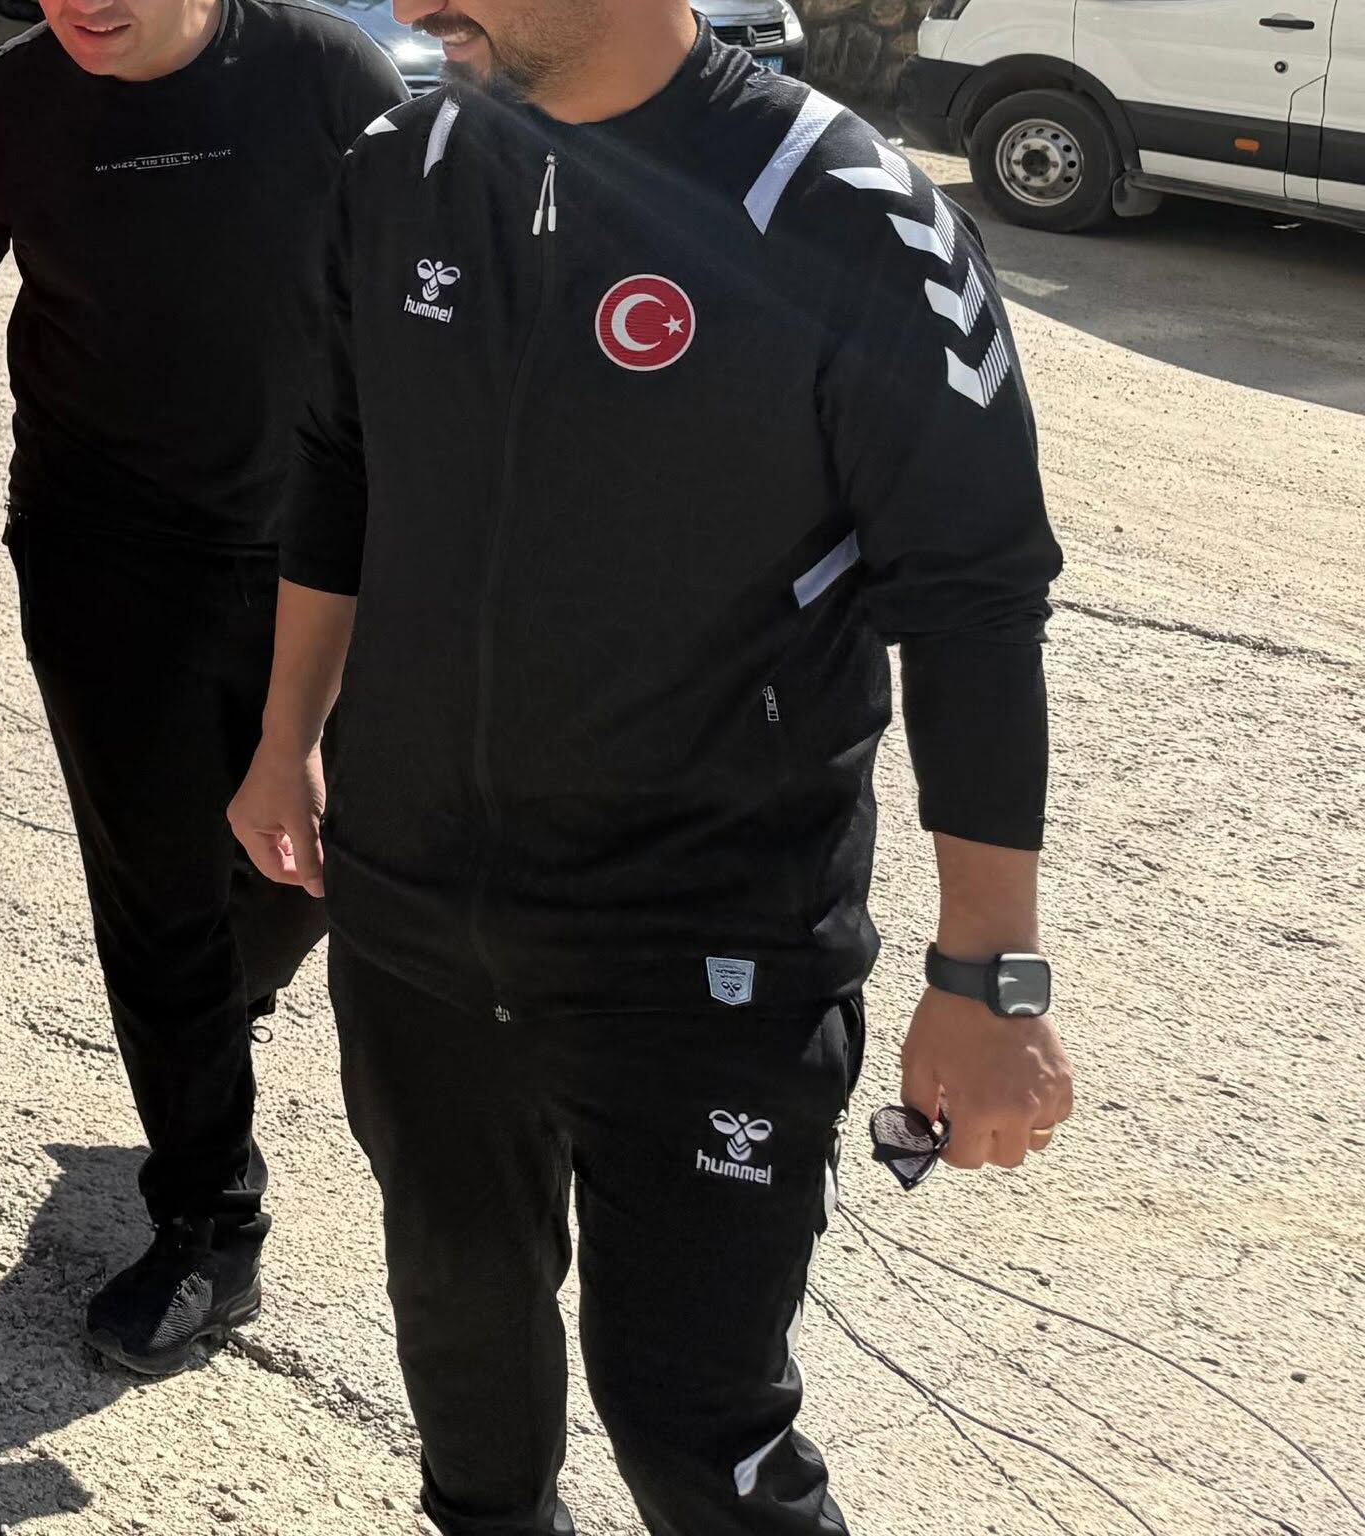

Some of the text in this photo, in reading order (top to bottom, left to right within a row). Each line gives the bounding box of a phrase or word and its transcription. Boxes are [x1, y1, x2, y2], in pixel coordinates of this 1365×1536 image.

[208, 149, 232, 158] ALIVE
[403, 294, 453, 324] hummel
[696, 1149, 772, 1185] hummel
